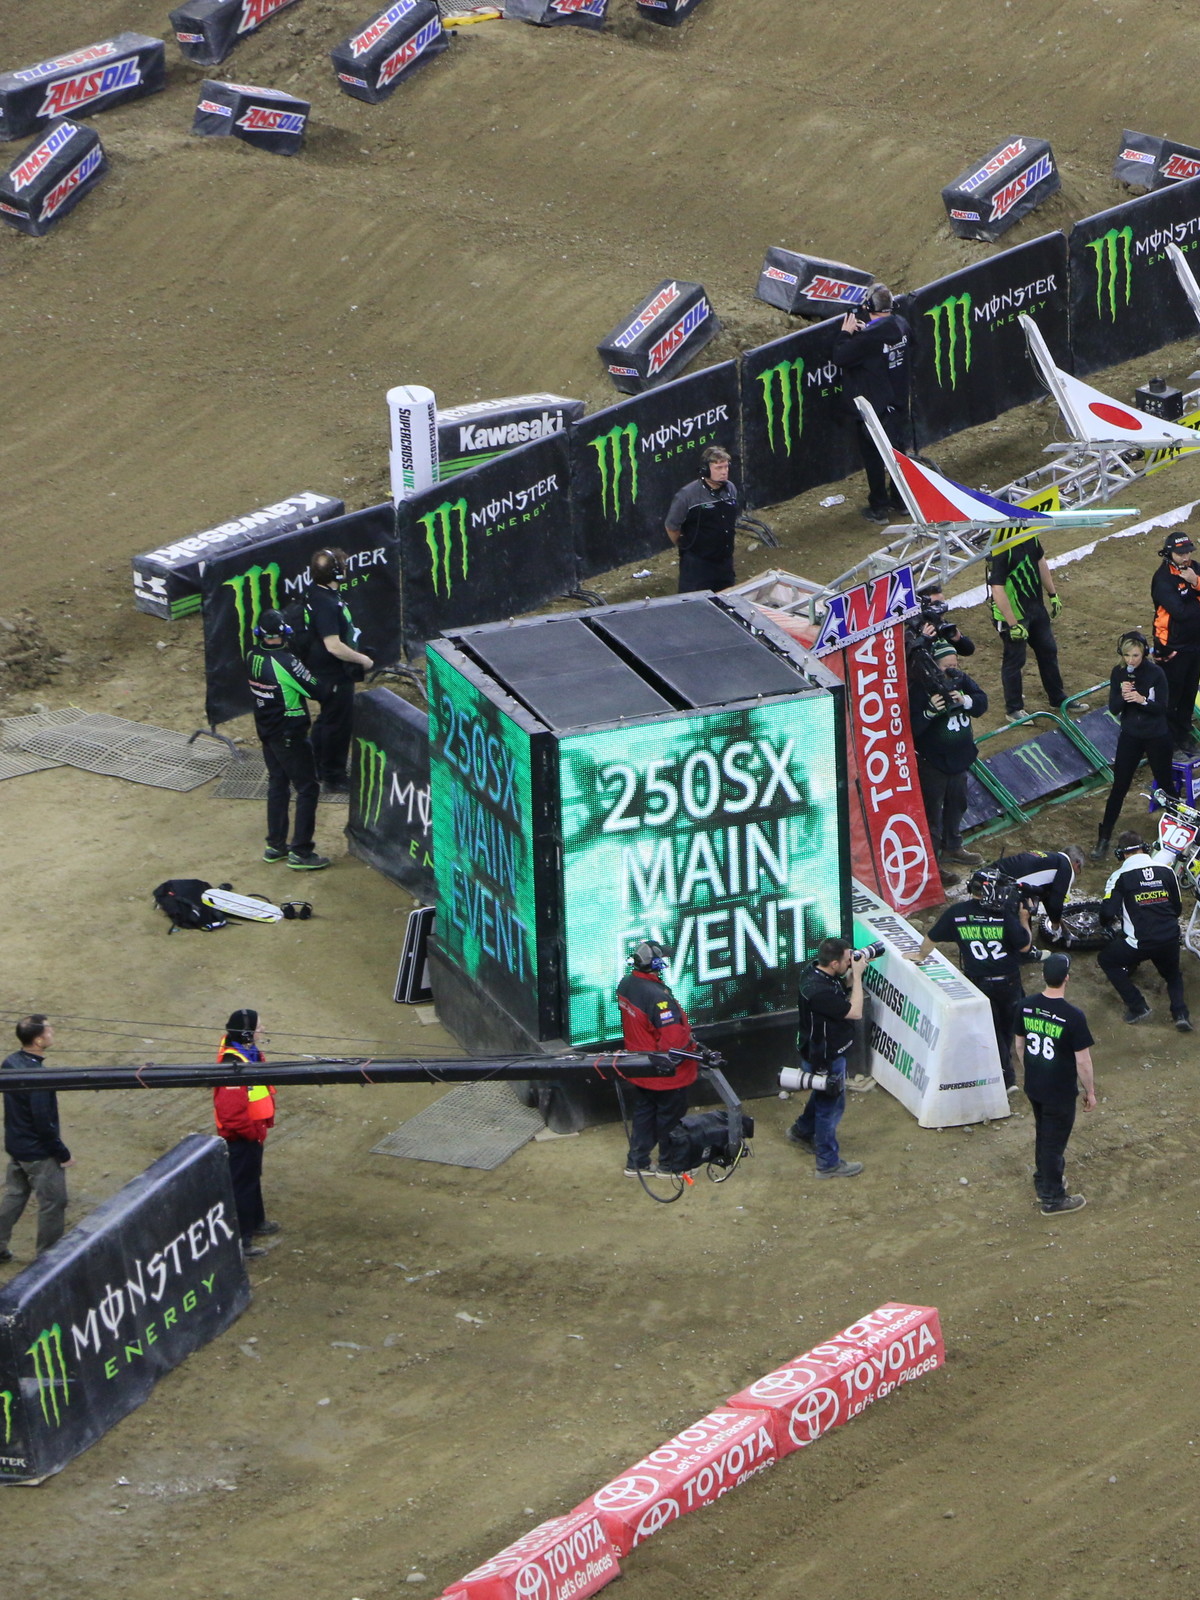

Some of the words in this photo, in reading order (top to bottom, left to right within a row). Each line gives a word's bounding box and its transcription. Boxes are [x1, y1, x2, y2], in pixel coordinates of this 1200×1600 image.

[376, 15, 441, 88] AMSOIL
[37, 56, 141, 118] AMSOIL
[197, 100, 231, 117] AMSOIL
[236, 106, 305, 134] AMSOIL
[10, 122, 77, 192] AMSOIL
[39, 144, 102, 222] AMSOIL
[959, 139, 1027, 192] AMSOIL
[1119, 149, 1156, 164] AMSOIL
[950, 209, 980, 221] AMSOIL
[989, 153, 1052, 223] AMSOIL
[763, 266, 798, 286] AMSOIL
[614, 281, 680, 348] AMSOIL
[646, 297, 710, 378] AMSOIL
[608, 364, 639, 377] AMSOIL
[459, 410, 564, 452] Kawasaki
[655, 432, 717, 463] ENERGY
[145, 492, 331, 565] Kawasaki
[486, 502, 548, 537] ENERGY
[813, 564, 921, 654] AMA
[883, 627, 900, 699] Places
[855, 634, 895, 813] TOYOTA
[889, 707, 903, 736] Go
[443, 697, 518, 821] 250SX
[603, 738, 802, 833] 250SX
[895, 741, 912, 792] Let's
[451, 781, 517, 896] MAIN
[1162, 821, 1188, 849] 16
[621, 821, 790, 914] MAIN
[451, 864, 527, 983] EVENT
[957, 926, 982, 940] TRACK
[982, 927, 1005, 939] CREW
[969, 940, 1008, 961] 02
[1023, 1016, 1044, 1032] TRACK
[1044, 1021, 1063, 1039] CREW
[1026, 1032, 1055, 1061] 36
[105, 1273, 217, 1381] ENERGY
[794, 1308, 906, 1364] TOYOTA
[878, 1310, 923, 1338] Places
[841, 1323, 936, 1399] TOYOTA
[847, 1393, 875, 1421] Let's
[877, 1381, 896, 1399] Go
[897, 1354, 938, 1387] Places
[631, 1413, 738, 1471] TOYOTA
[666, 1453, 700, 1475] Let's
[695, 1439, 719, 1454] Go
[713, 1415, 757, 1444] Places
[683, 1426, 774, 1507] TOYOTA
[544, 1519, 607, 1580] TOYOTA
[574, 1570, 587, 1590] Go
[587, 1553, 613, 1582] Places
